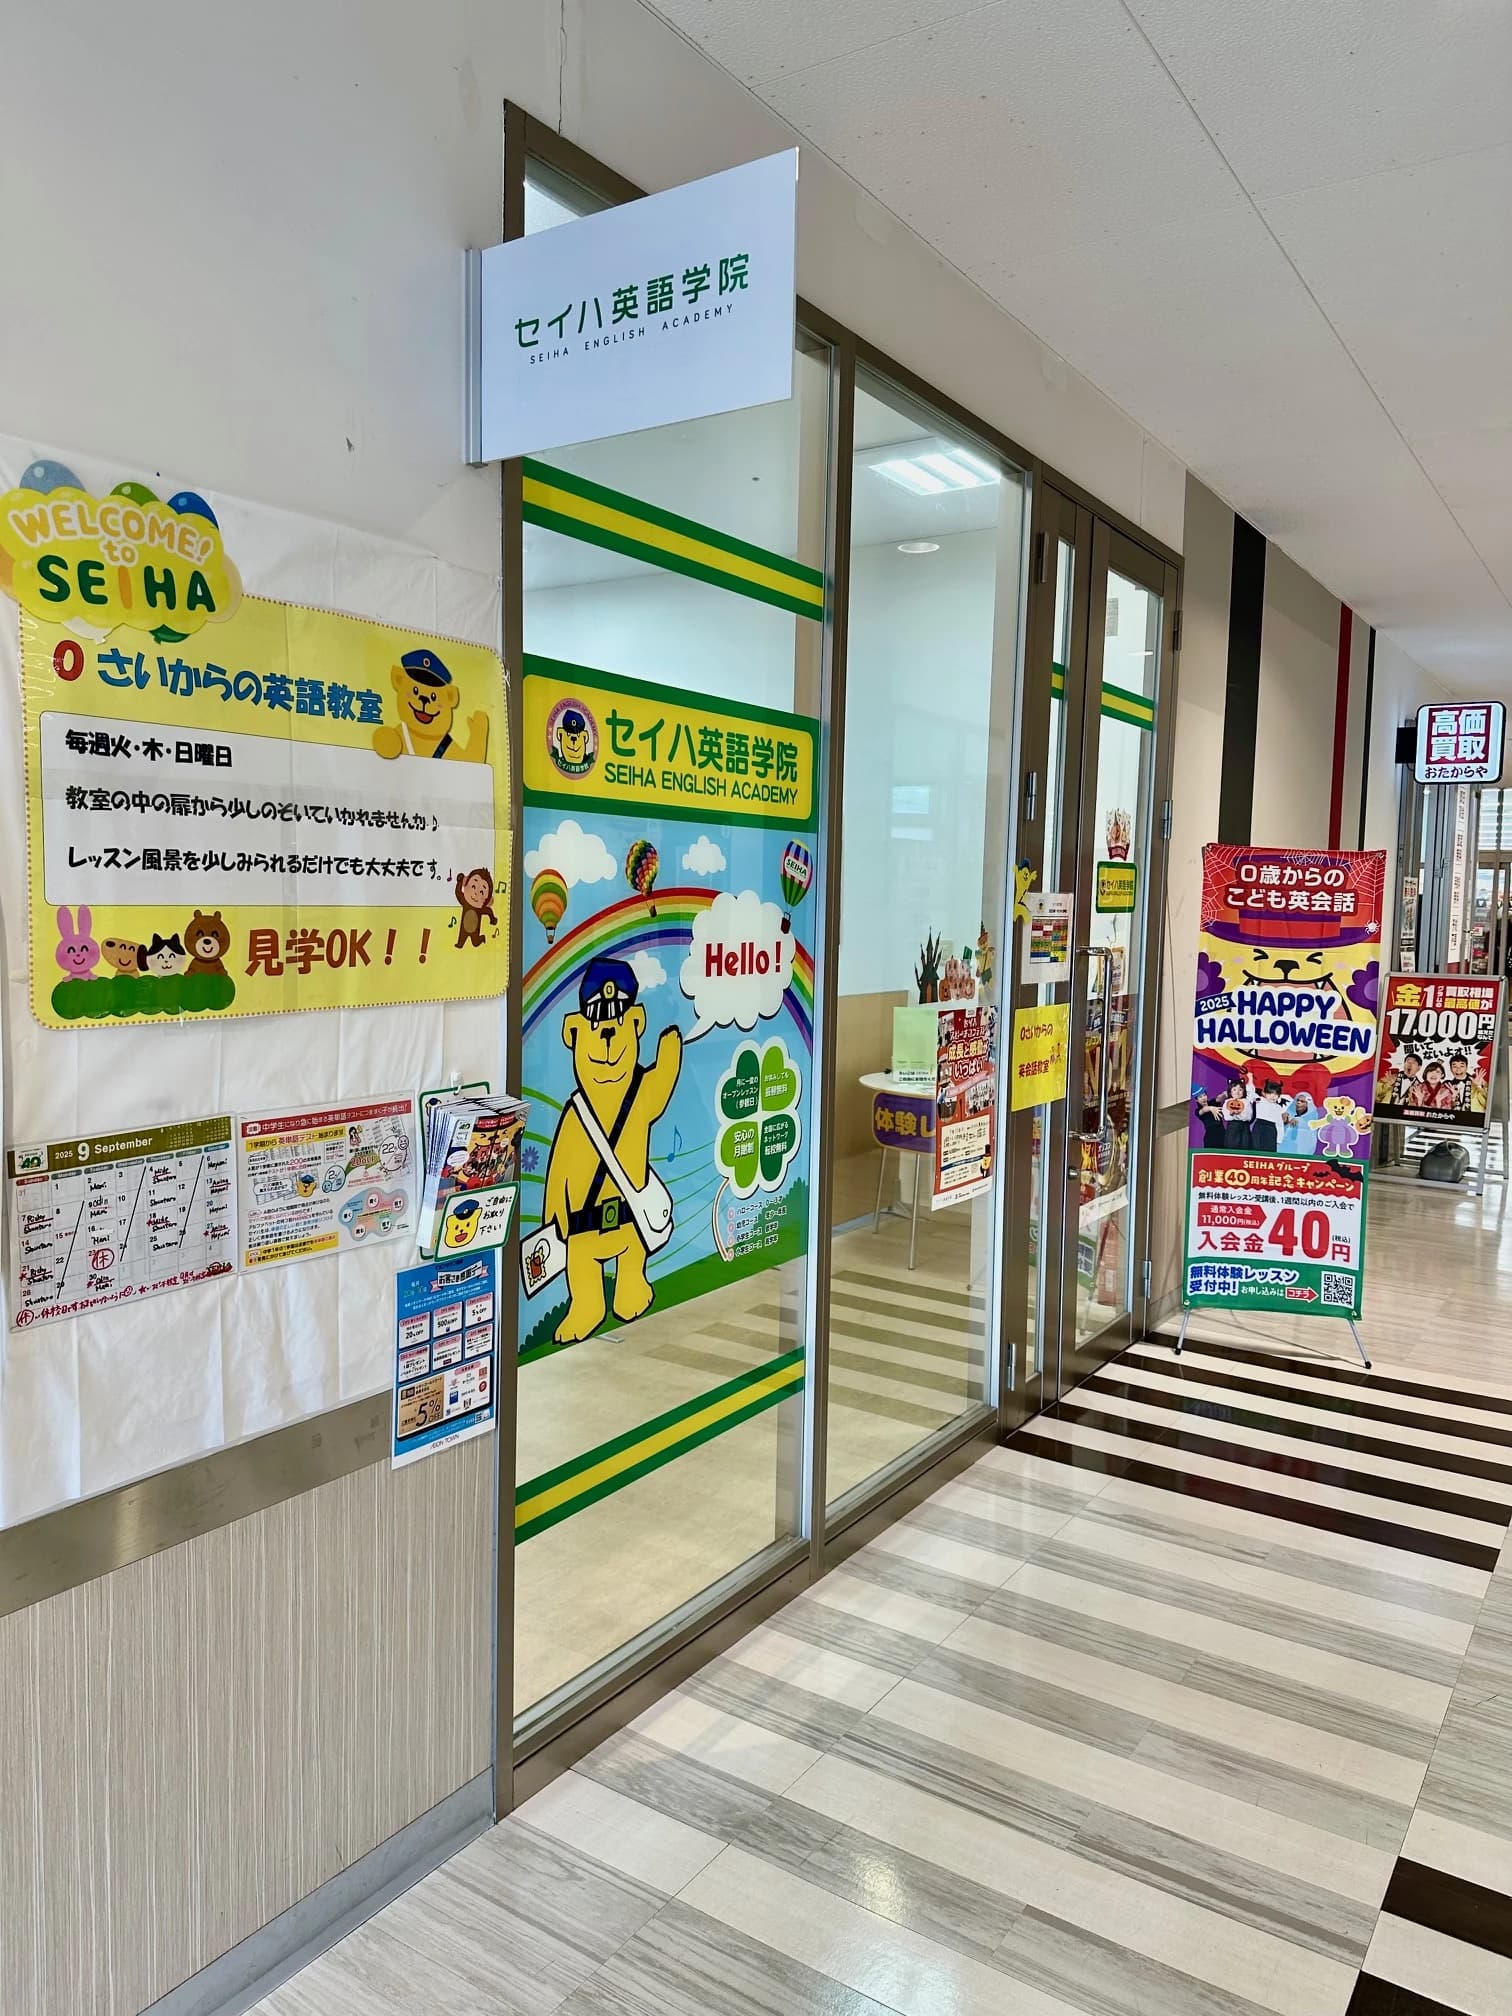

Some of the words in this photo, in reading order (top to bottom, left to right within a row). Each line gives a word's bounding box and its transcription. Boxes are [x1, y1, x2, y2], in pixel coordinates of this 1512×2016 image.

[514, 253, 749, 348] セイハ英語学院
[529, 347, 569, 365] SEIHA
[584, 327, 646, 351] ENGLISH
[662, 303, 734, 330] ACADEMY
[11, 502, 213, 563] WELCOME!
[103, 541, 136, 562] to
[37, 555, 216, 612] SEIHA
[97, 647, 384, 725] さいからの英語教室
[1431, 709, 1488, 735] 高価
[65, 729, 233, 768] 毎週火・木・日曜日
[605, 708, 797, 782] セイハ英語学院
[1429, 736, 1487, 761] 買取
[1424, 765, 1488, 778] おたからや
[604, 762, 656, 788] SEIHA
[661, 773, 726, 797] ENGLISH
[731, 781, 798, 805] ACADEMY
[68, 846, 442, 882] レッスン風景を少しみられるだけでも大丈夫です。
[786, 858, 807, 877] SEIHA
[1240, 864, 1345, 887] 0歳からの
[1227, 887, 1355, 912] こども英会話
[1200, 994, 1229, 1012] 2025
[1237, 990, 1335, 1020] HAPPY
[1197, 1018, 1372, 1054] HALLOWEEN
[1426, 1111, 1456, 1120] おたからや
[734, 1128, 755, 1144] 安心の
[55, 1150, 73, 1159] 2025
[78, 1142, 90, 1161] 9
[94, 1137, 153, 1154] September
[382, 1143, 395, 1154] 22
[329, 1170, 335, 1180] 2
[1243, 1160, 1274, 1170] SEIHA
[1277, 1162, 1311, 1173] グループ
[1209, 1205, 1253, 1216] 通常入会金
[55, 1232, 64, 1240] 15
[480, 1223, 501, 1235] 下さい
[1189, 1265, 1298, 1283] 無料体験レッスン
[1240, 1286, 1283, 1297] お申し込みは
[1288, 1289, 1310, 1299] コチラ
